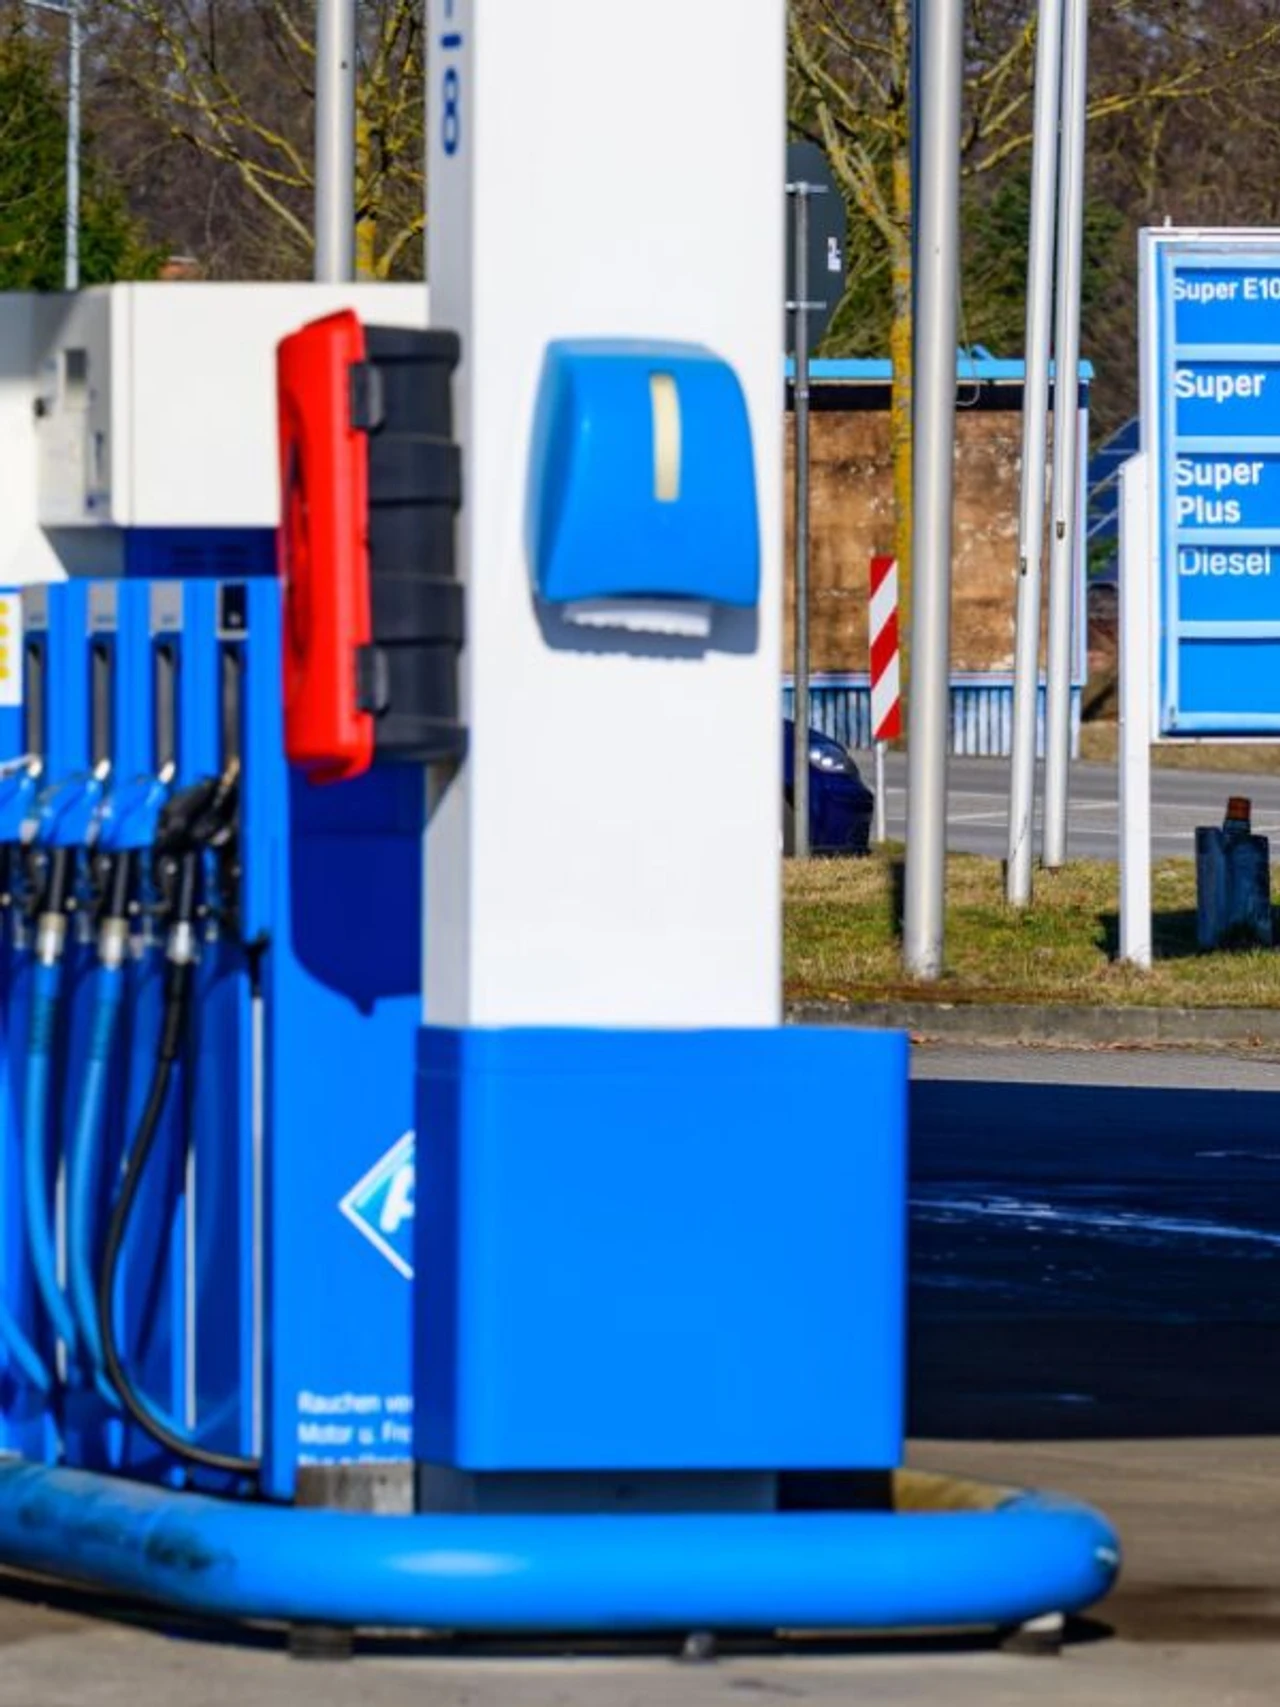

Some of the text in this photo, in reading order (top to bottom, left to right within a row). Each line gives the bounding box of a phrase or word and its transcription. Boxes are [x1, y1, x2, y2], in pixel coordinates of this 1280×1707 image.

[1174, 277, 1239, 303] Super
[1174, 368, 1266, 403] Super
[1175, 458, 1264, 491] Super
[1176, 495, 1241, 524] Plus
[1178, 547, 1272, 576] Diesel
